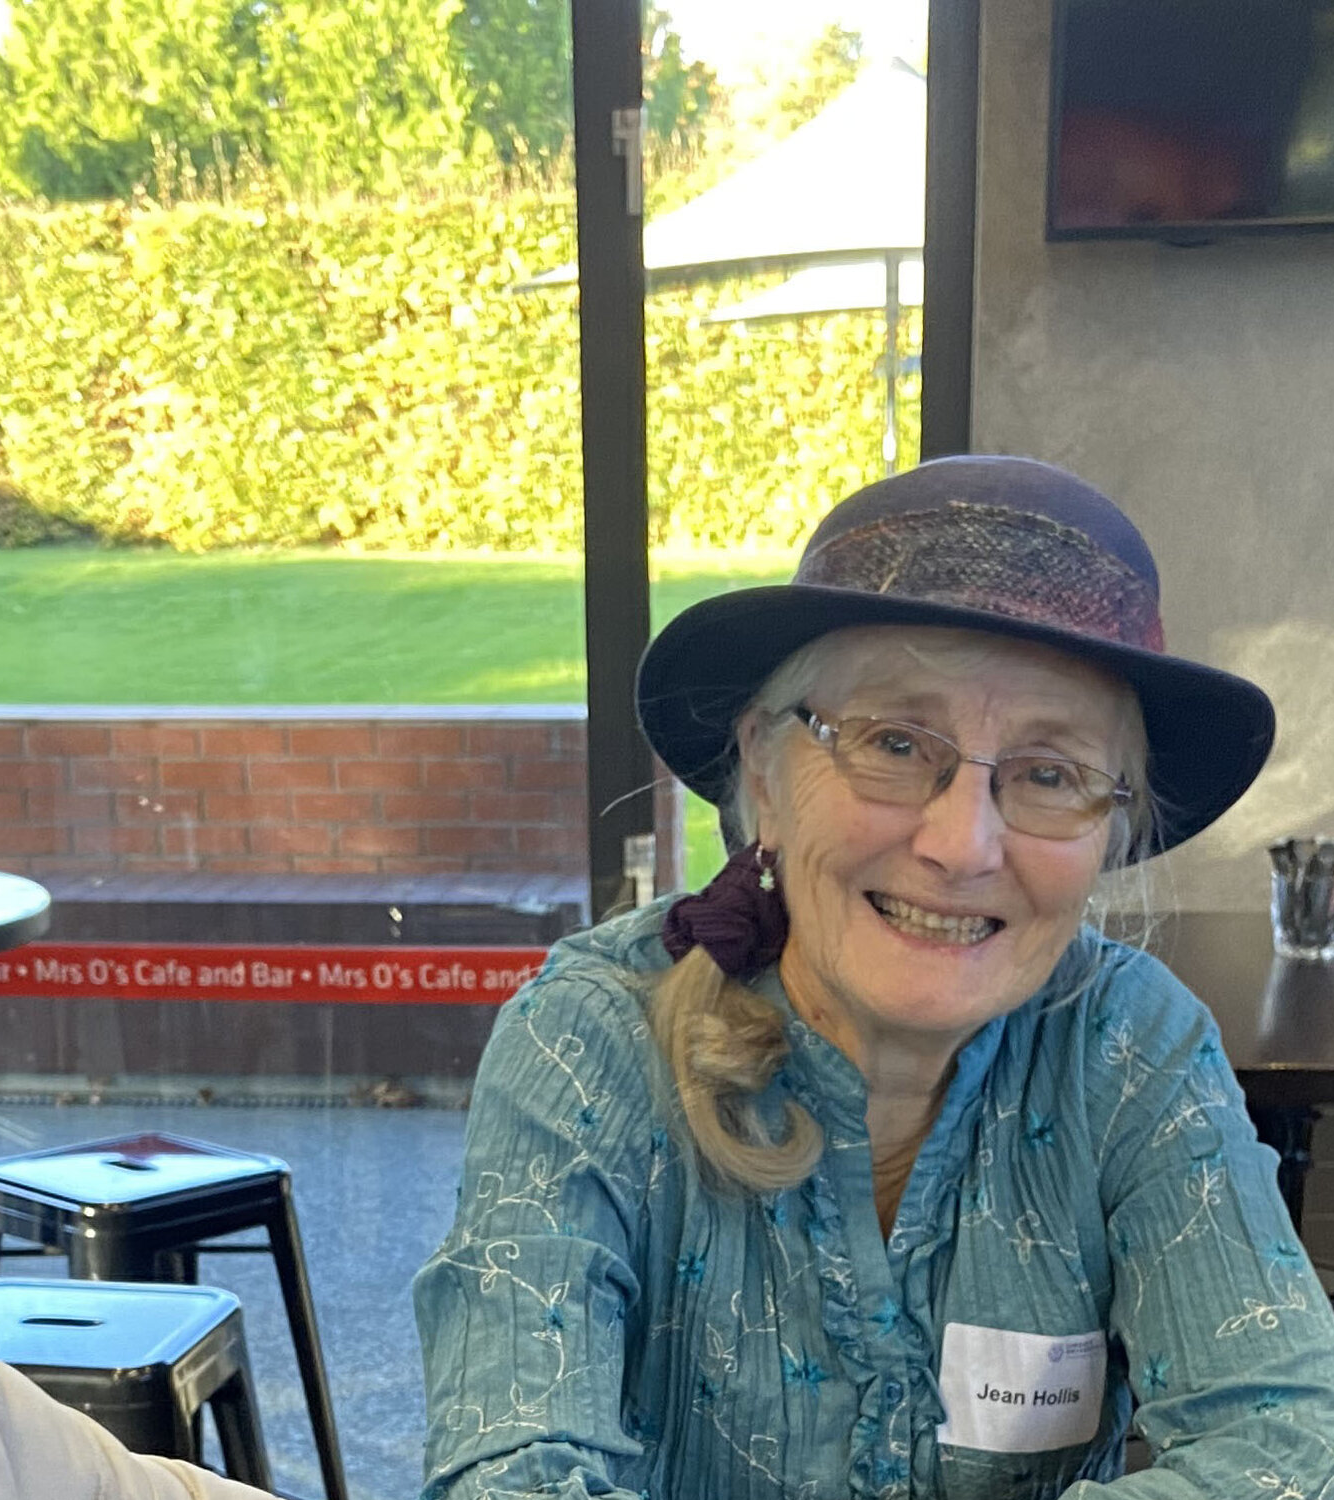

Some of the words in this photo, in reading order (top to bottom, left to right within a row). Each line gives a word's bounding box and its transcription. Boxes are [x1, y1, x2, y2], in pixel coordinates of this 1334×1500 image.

[33, 959, 83, 985] Mrs
[87, 959, 129, 986] O's
[133, 959, 192, 987] Cafe
[197, 961, 245, 987] and
[251, 961, 295, 988] Bar
[318, 963, 367, 988] Mrs
[372, 963, 414, 989] O's
[419, 964, 477, 990] Cafe
[976, 1383, 1025, 1405] Jean
[1032, 1388, 1080, 1407] Hollis
